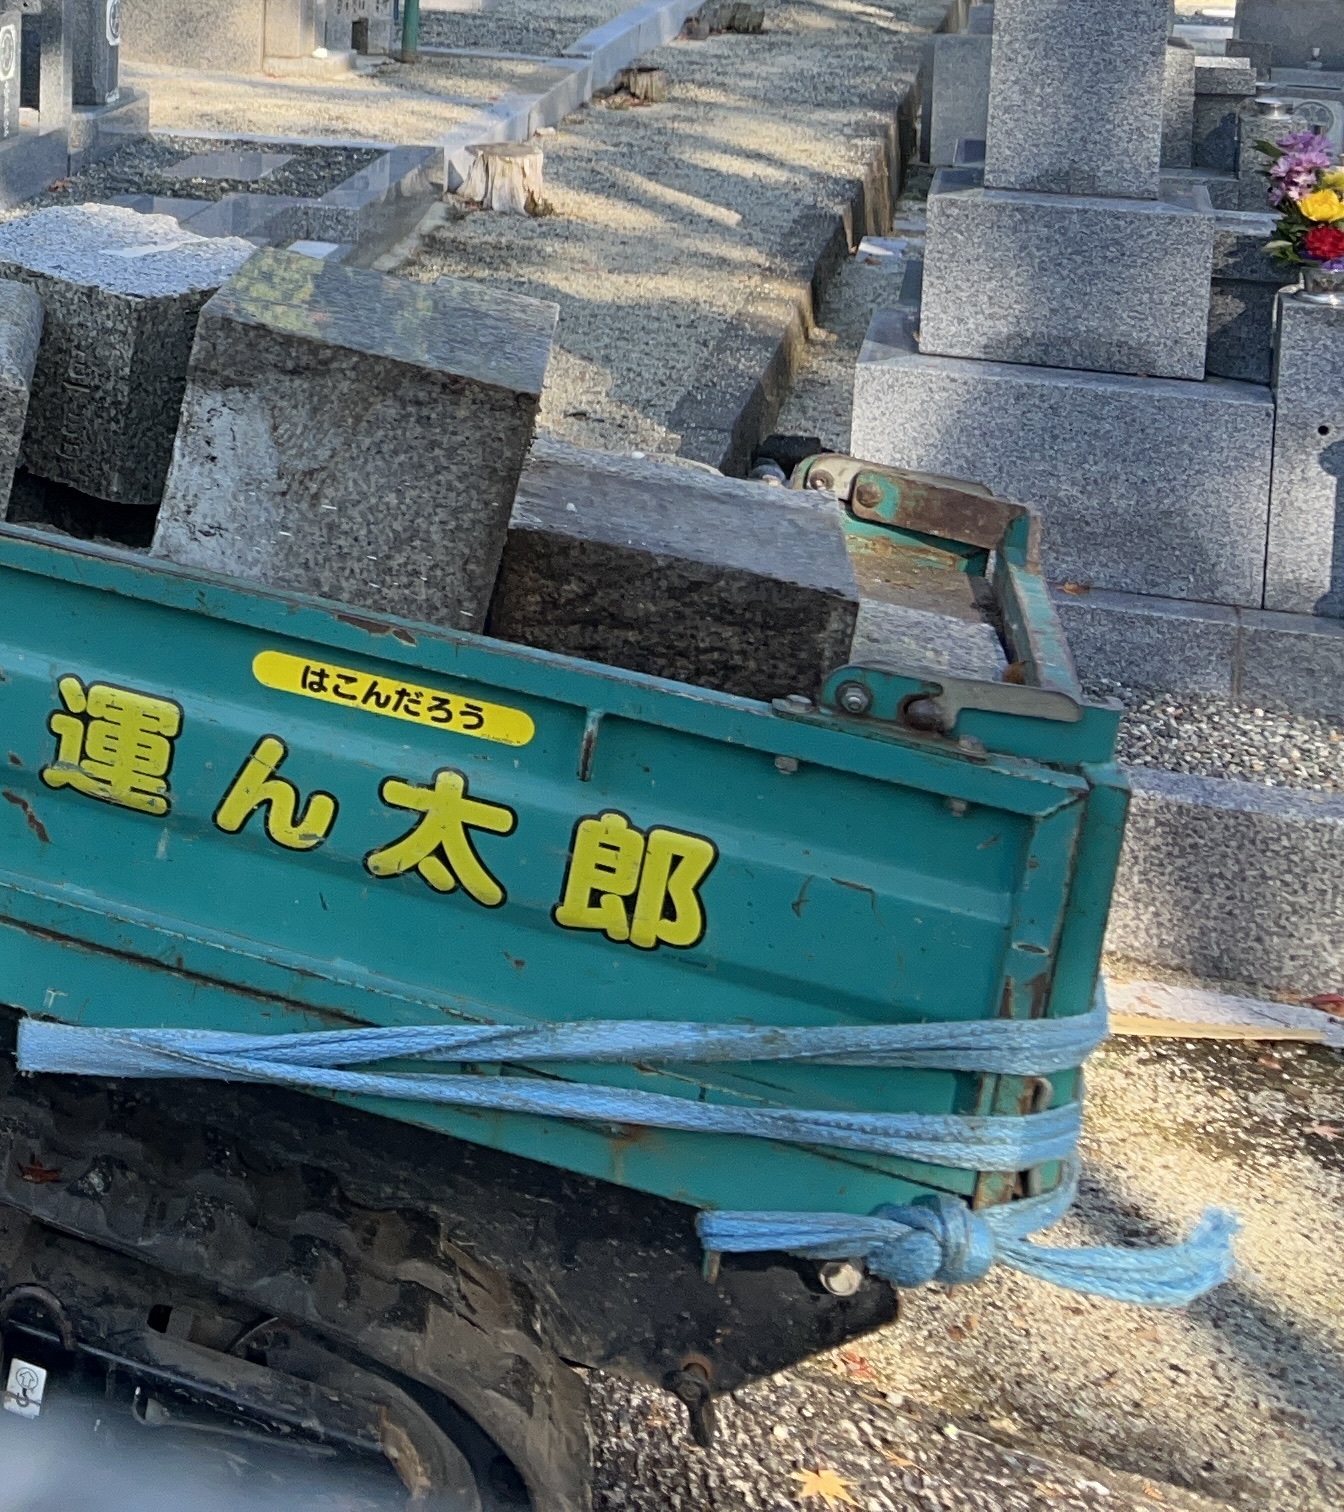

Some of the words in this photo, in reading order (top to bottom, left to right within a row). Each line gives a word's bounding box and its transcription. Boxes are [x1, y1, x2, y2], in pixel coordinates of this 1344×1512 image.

[301, 665, 485, 730] はこんだろう
[39, 673, 718, 951] 運ん太郎
